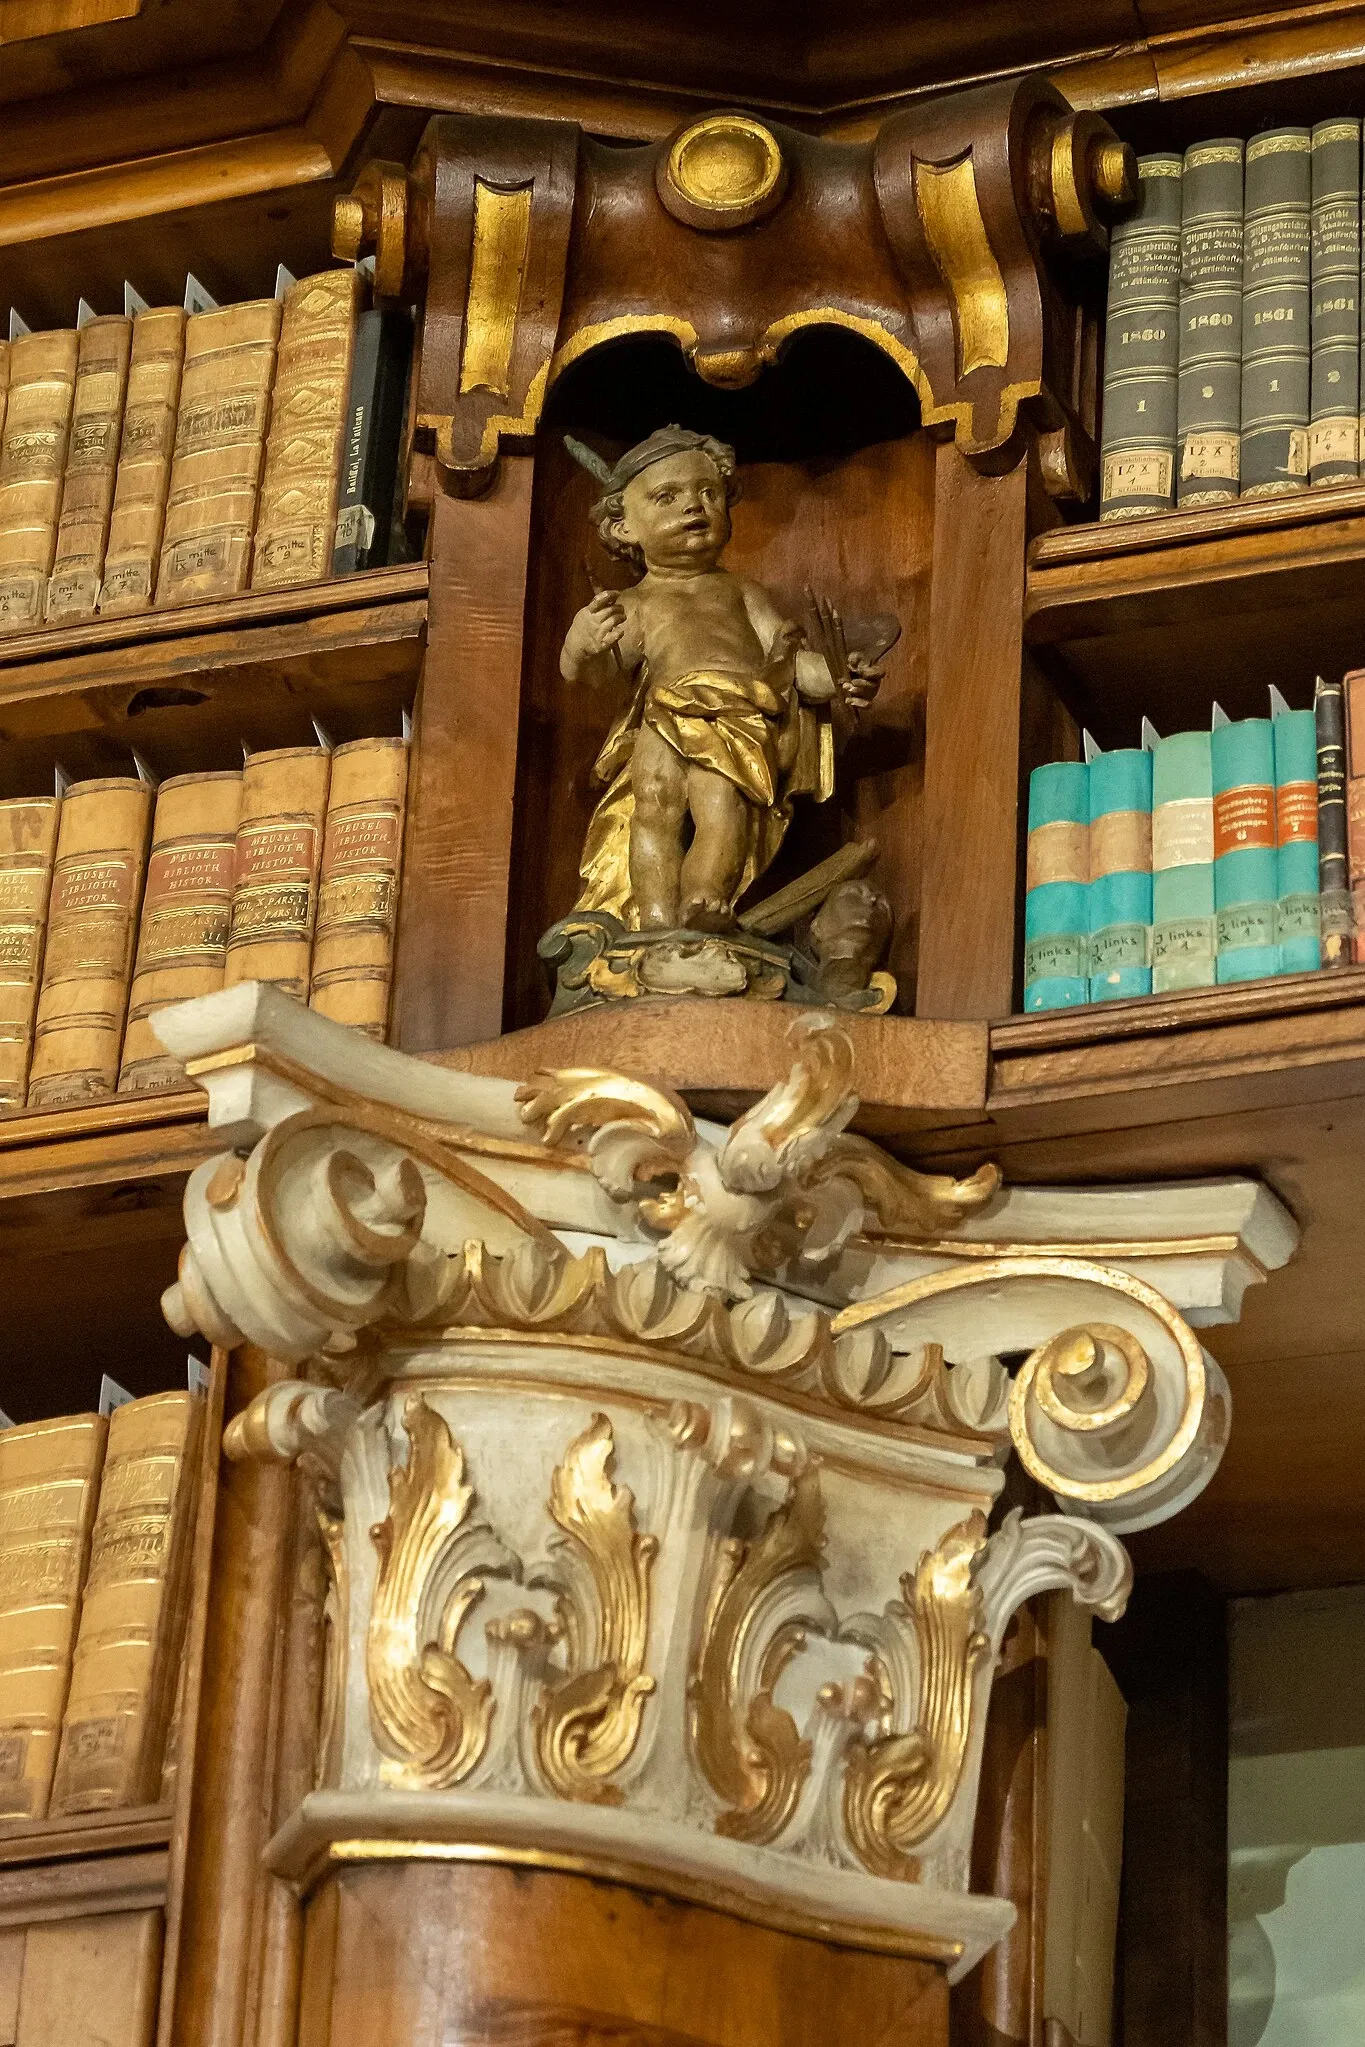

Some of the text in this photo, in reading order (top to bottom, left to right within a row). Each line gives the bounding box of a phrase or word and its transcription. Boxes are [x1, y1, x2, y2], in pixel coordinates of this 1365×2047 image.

[1315, 298, 1355, 317] 1861
[1186, 313, 1233, 332] 1860
[1253, 308, 1294, 325] 1861
[1121, 329, 1166, 345] 1860
[1269, 379, 1279, 392] 1
[1136, 399, 1147, 412] 1
[349, 444, 360, 457] La
[276, 540, 305, 552] mitte
[176, 548, 217, 563] L mitte
[175, 558, 203, 571] IX 8
[112, 569, 140, 580] mitte
[120, 581, 128, 590] 7
[65, 593, 73, 601] 7
[2, 602, 9, 611] 6
[334, 821, 381, 836] MEUSEL
[250, 832, 299, 846] MEUSEL
[169, 850, 218, 865] MEUSEL
[250, 856, 301, 872] HISTOR.
[66, 869, 112, 884] MEUSEL
[168, 877, 219, 890] HISTOR.
[65, 893, 115, 908] HISTOR.
[1285, 903, 1318, 916] links
[1231, 916, 1265, 929] links
[1294, 916, 1302, 925] 1
[1168, 929, 1203, 942] links
[1244, 927, 1250, 936] 1
[1104, 937, 1138, 950] links
[1155, 941, 1189, 956] IX 1
[1038, 947, 1072, 961] links
[1115, 947, 1123, 957] 1
[1048, 957, 1057, 967] 1
